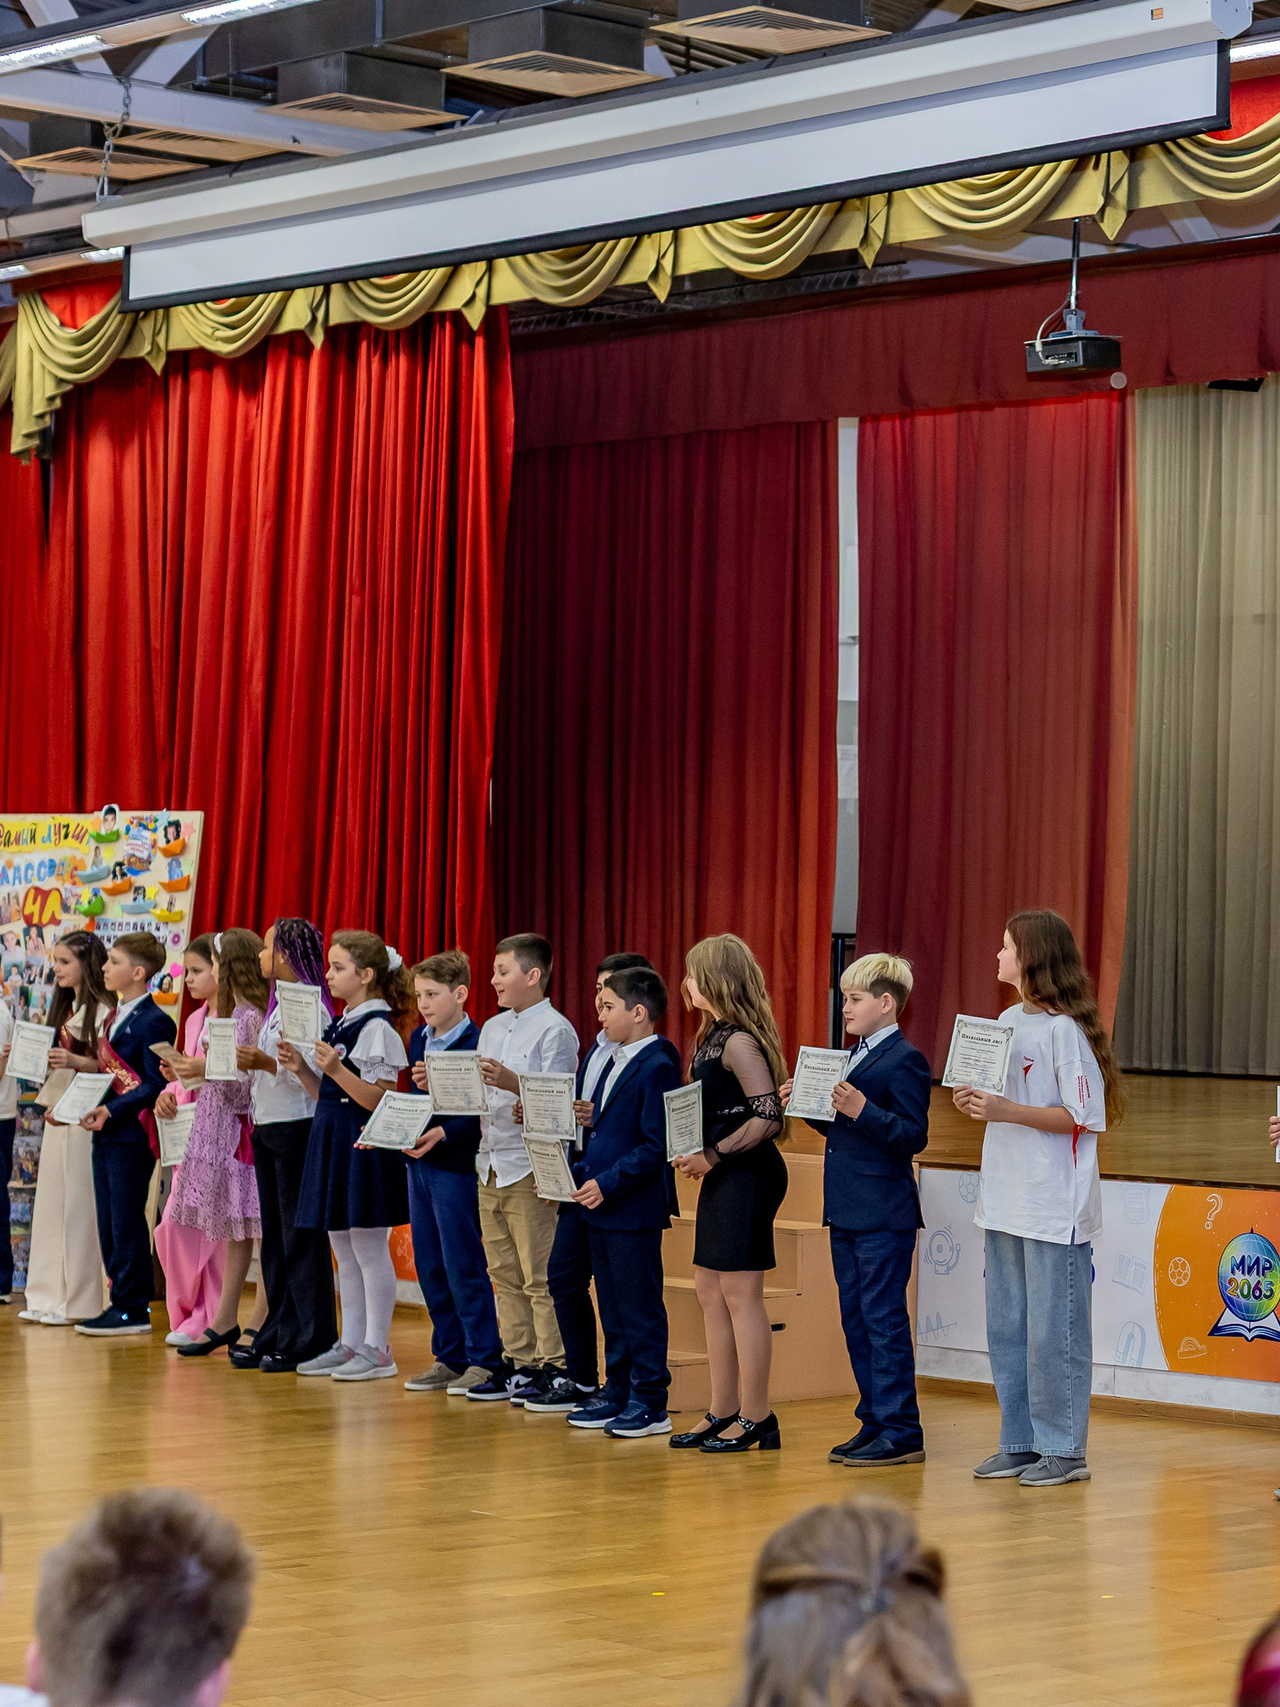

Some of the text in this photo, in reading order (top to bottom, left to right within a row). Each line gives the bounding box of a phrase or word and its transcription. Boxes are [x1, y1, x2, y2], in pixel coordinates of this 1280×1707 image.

[41, 822, 91, 847] лучш
[1230, 1255, 1274, 1278] МИР
[1227, 1278, 1275, 1301] 2065
